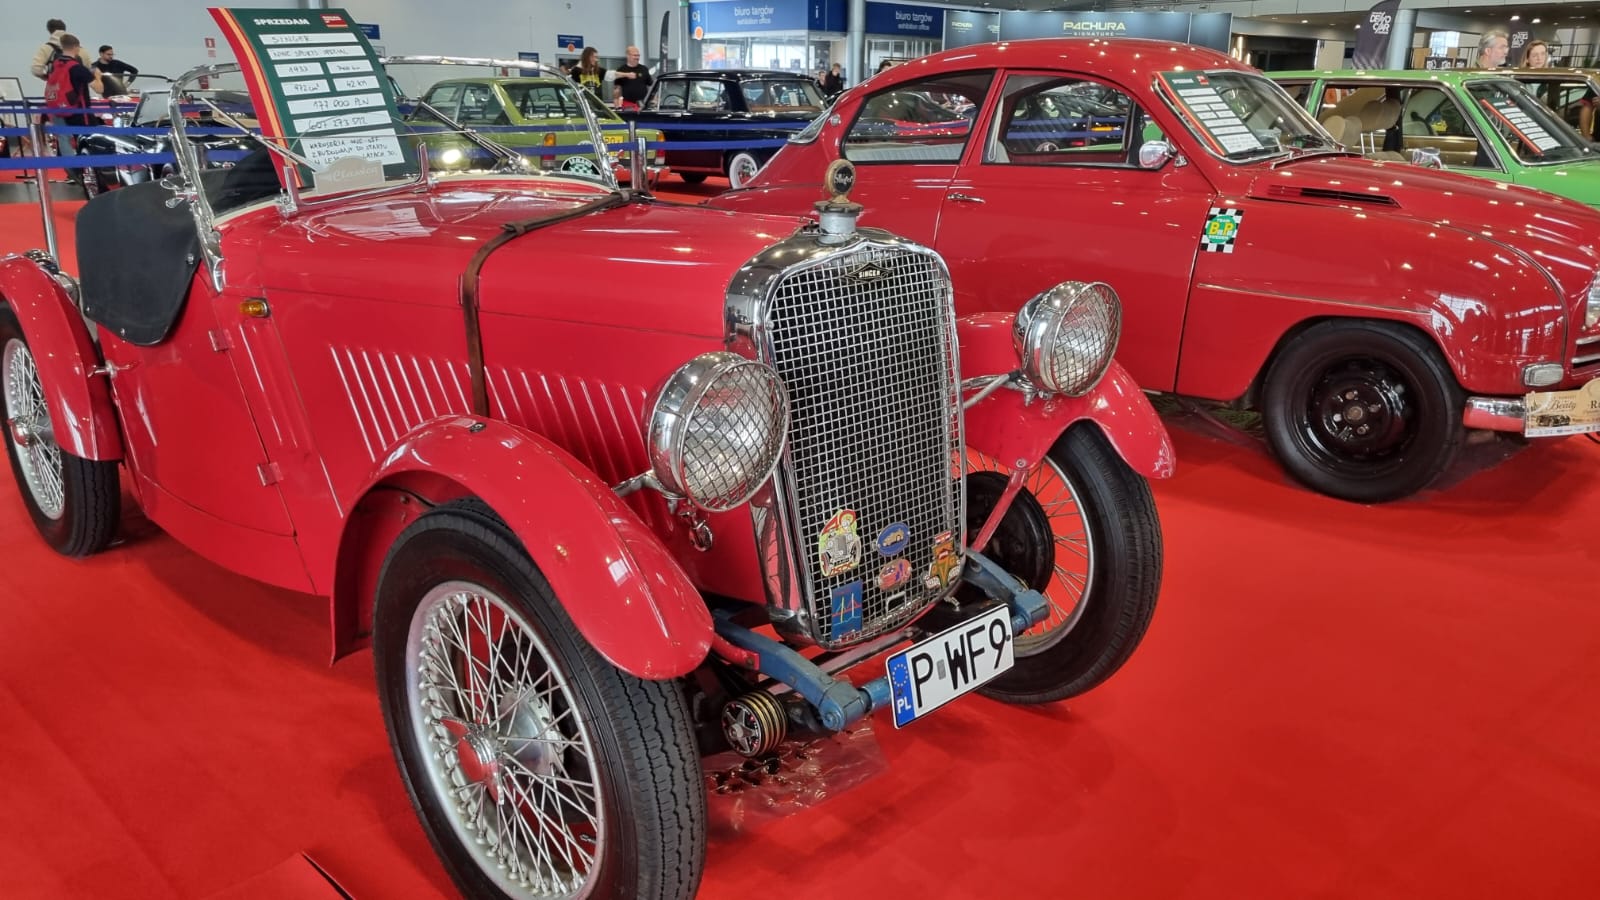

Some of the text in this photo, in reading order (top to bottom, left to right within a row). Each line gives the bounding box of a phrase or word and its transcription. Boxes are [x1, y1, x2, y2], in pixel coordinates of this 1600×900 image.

[734, 5, 774, 17] biuro targów
[896, 10, 933, 24] biuro targów
[313, 100, 329, 111] 177
[354, 98, 369, 106] PLN
[858, 269, 880, 278] SINGER
[1591, 400, 1600, 409] R
[897, 697, 912, 714] PL
